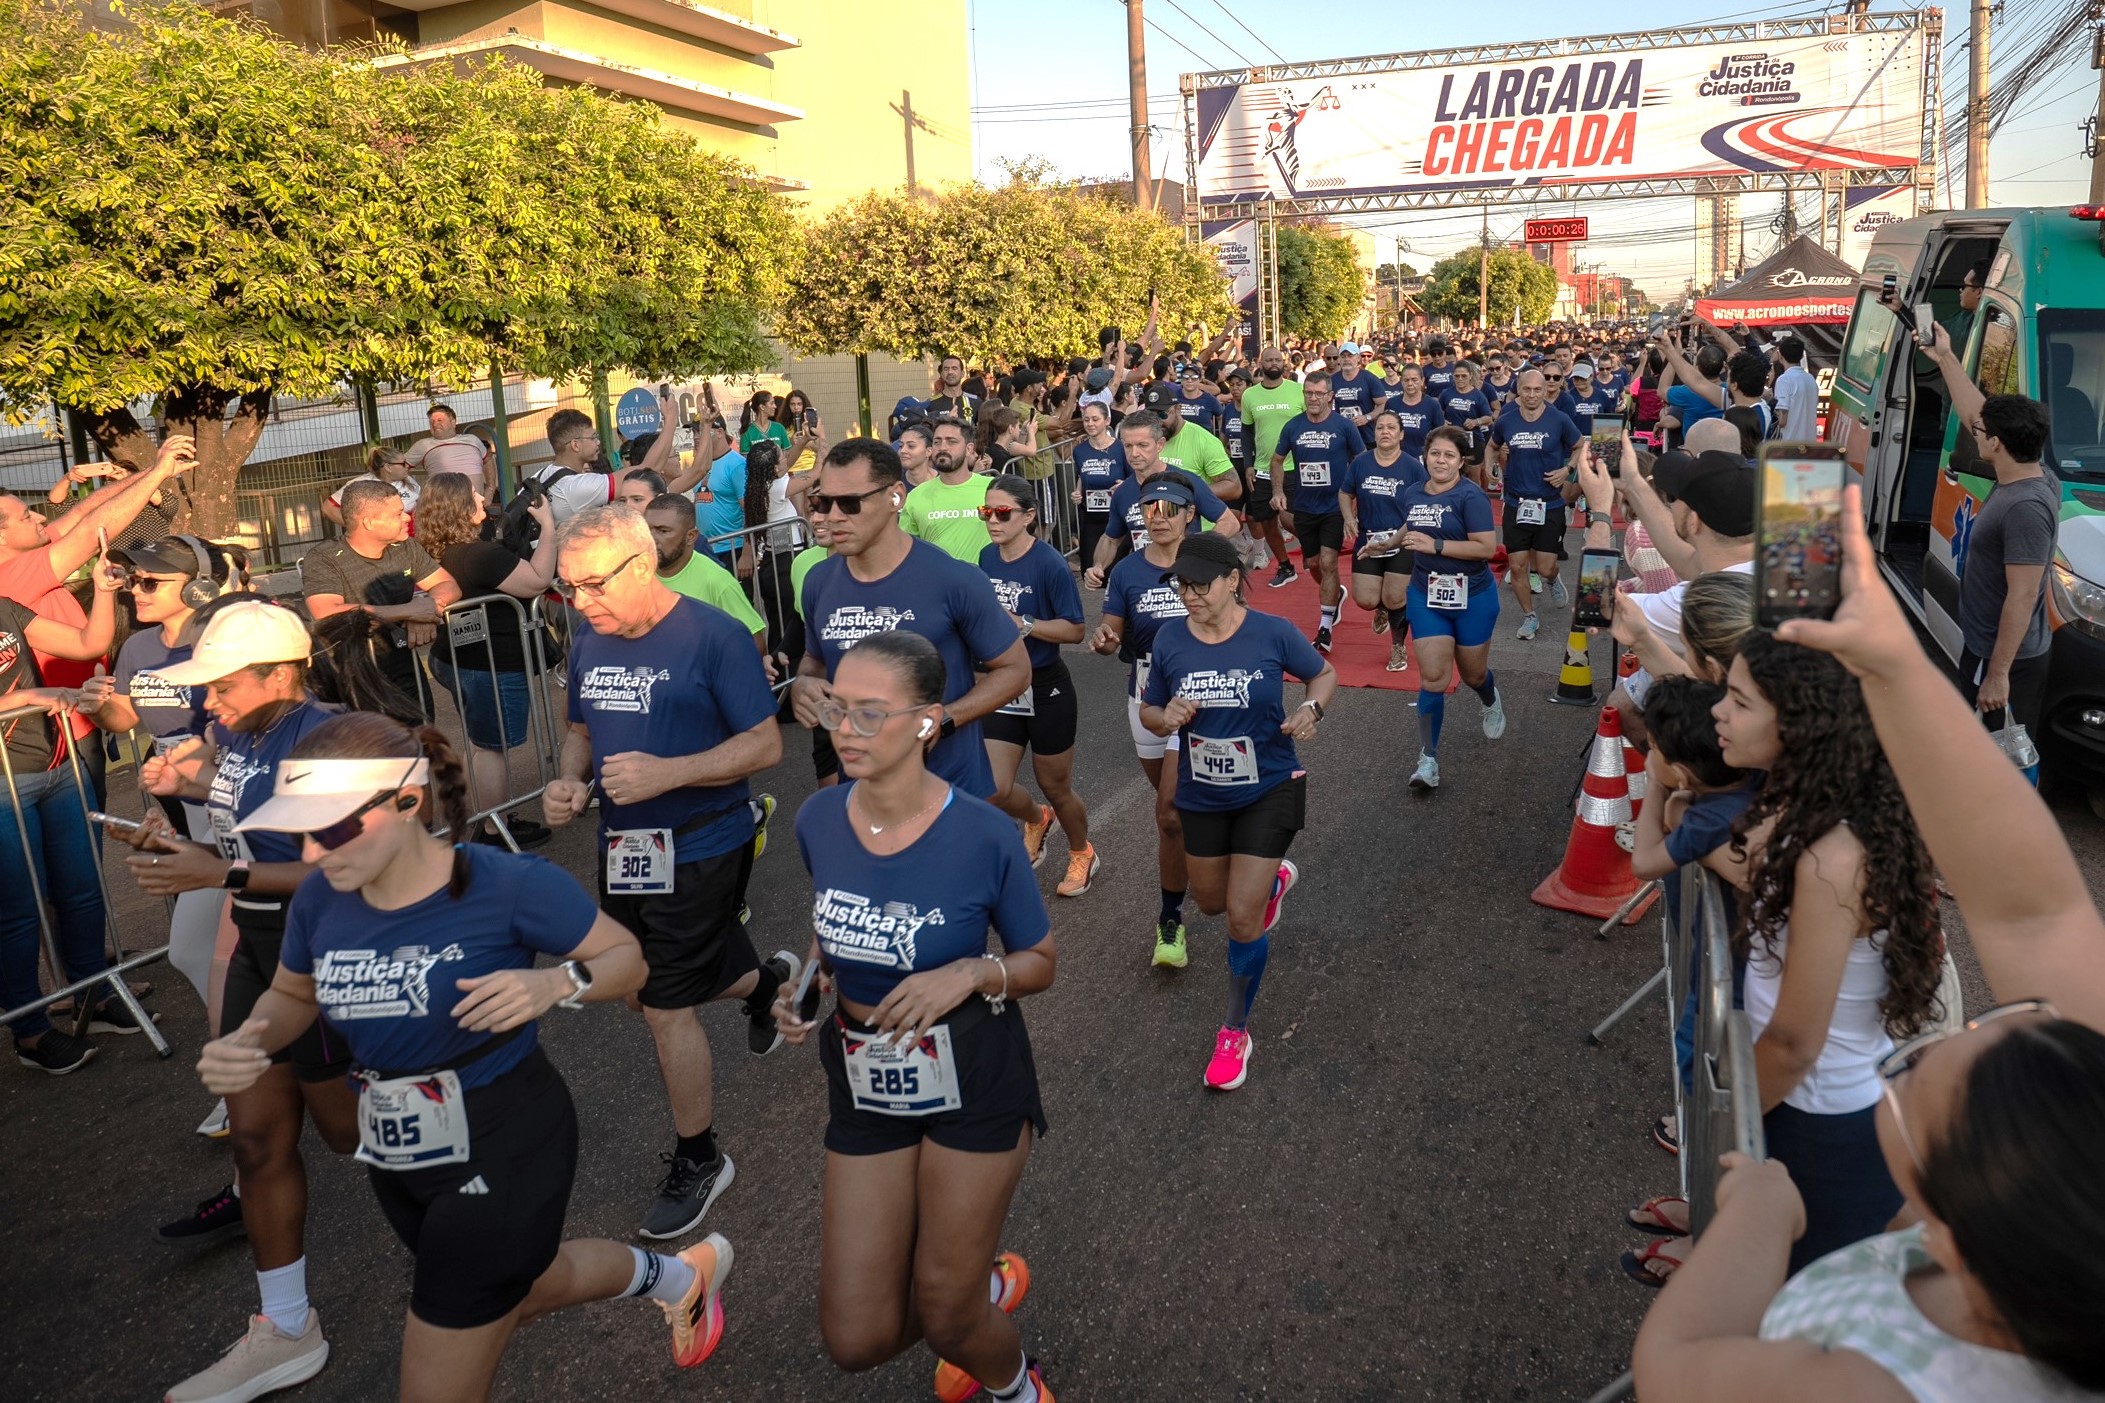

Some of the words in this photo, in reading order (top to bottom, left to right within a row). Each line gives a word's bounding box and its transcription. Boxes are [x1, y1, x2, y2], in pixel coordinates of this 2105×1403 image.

[1709, 56, 1795, 80] Justiça
[1434, 58, 1643, 123] LARGADA
[1699, 77, 1791, 97] Cidadania
[1422, 111, 1638, 176] CHEGADA
[618, 414, 655, 426] GRÁTIS
[1306, 472, 1321, 480] 443
[928, 509, 960, 520] COFCO
[1523, 509, 1534, 518] 85
[1436, 589, 1456, 601] 502
[829, 608, 884, 628] Justiça
[584, 667, 640, 688] Justiça
[1181, 673, 1236, 691] Justiça
[580, 685, 637, 701] Cidadania
[1177, 687, 1235, 701] Cidadania
[1203, 756, 1235, 774] 442
[620, 856, 652, 878] 302
[816, 888, 897, 933] Justiça
[315, 950, 406, 984] Justiça
[868, 1066, 919, 1095] 285
[368, 1113, 421, 1148] 485
